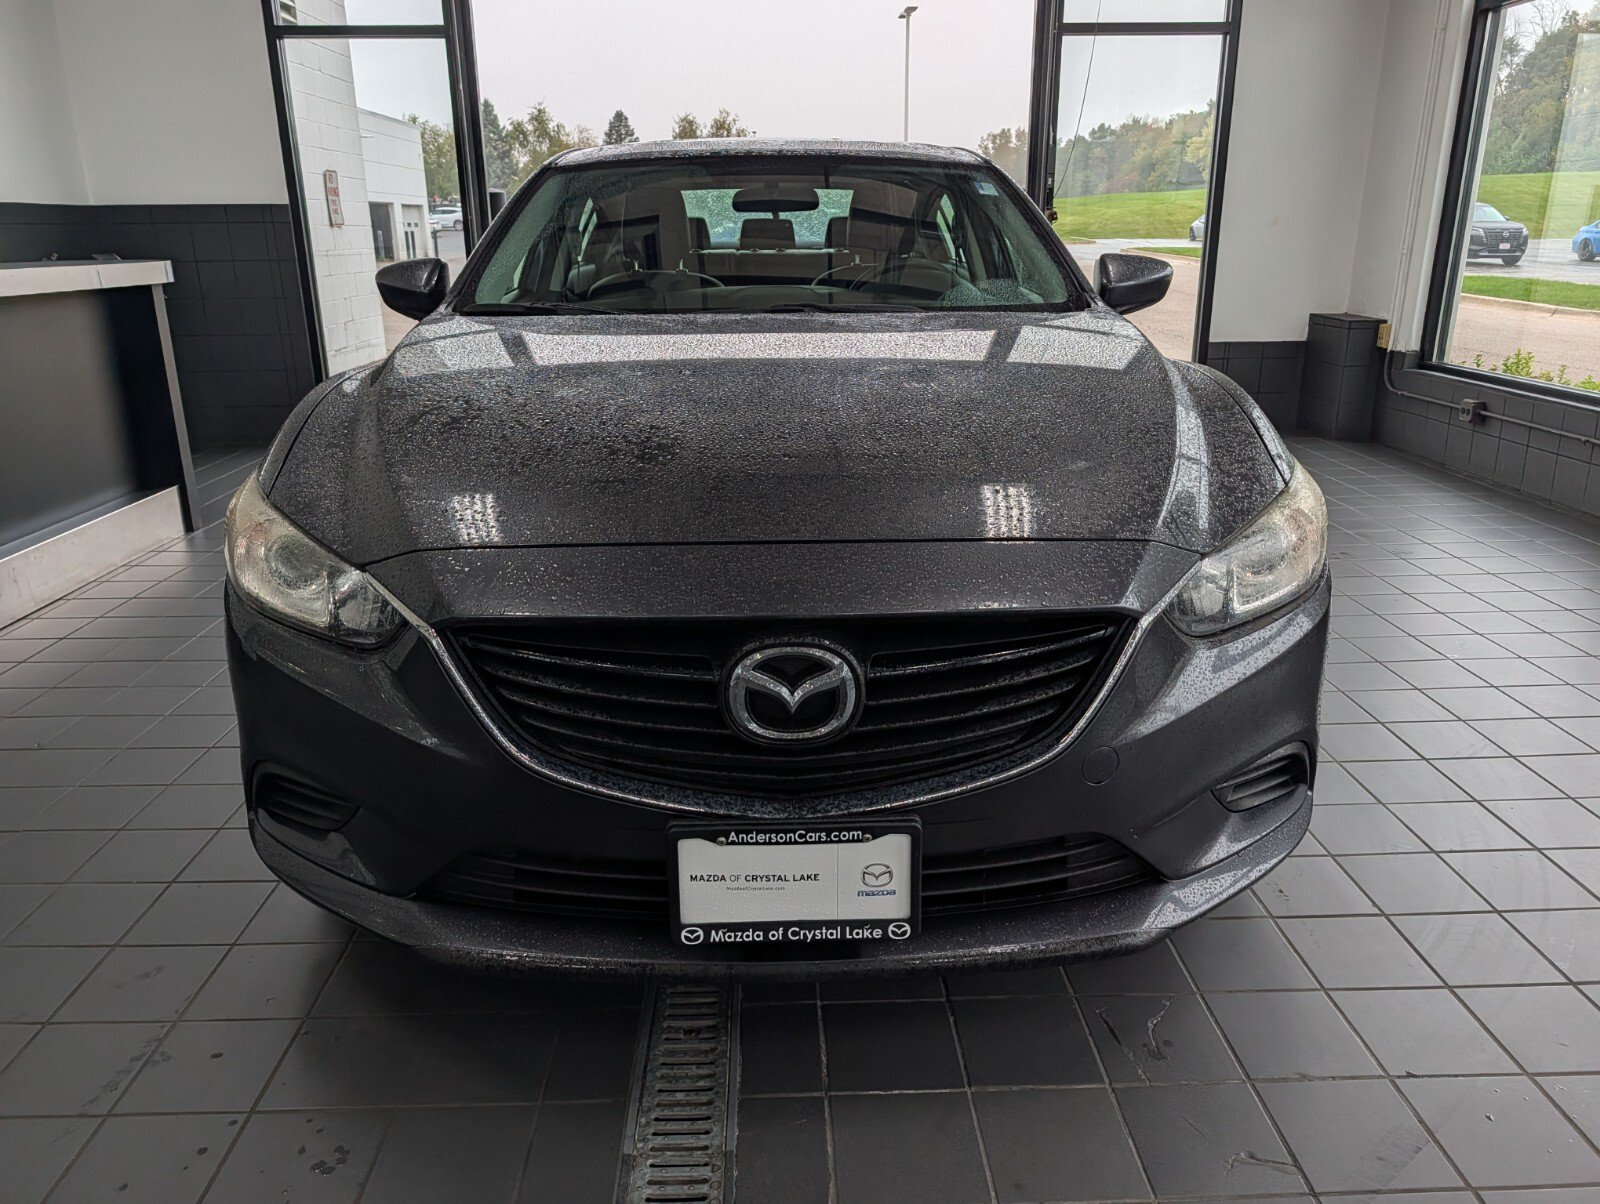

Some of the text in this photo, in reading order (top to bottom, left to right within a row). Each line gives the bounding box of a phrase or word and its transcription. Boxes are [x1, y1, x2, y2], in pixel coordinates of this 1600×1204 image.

[728, 830, 862, 843] AndersonCars.com
[690, 873, 820, 883] MAZDA OF CRYSTAL LAKE
[857, 889, 896, 897] mazda
[710, 924, 883, 942] Mazda of Crystal Lake
